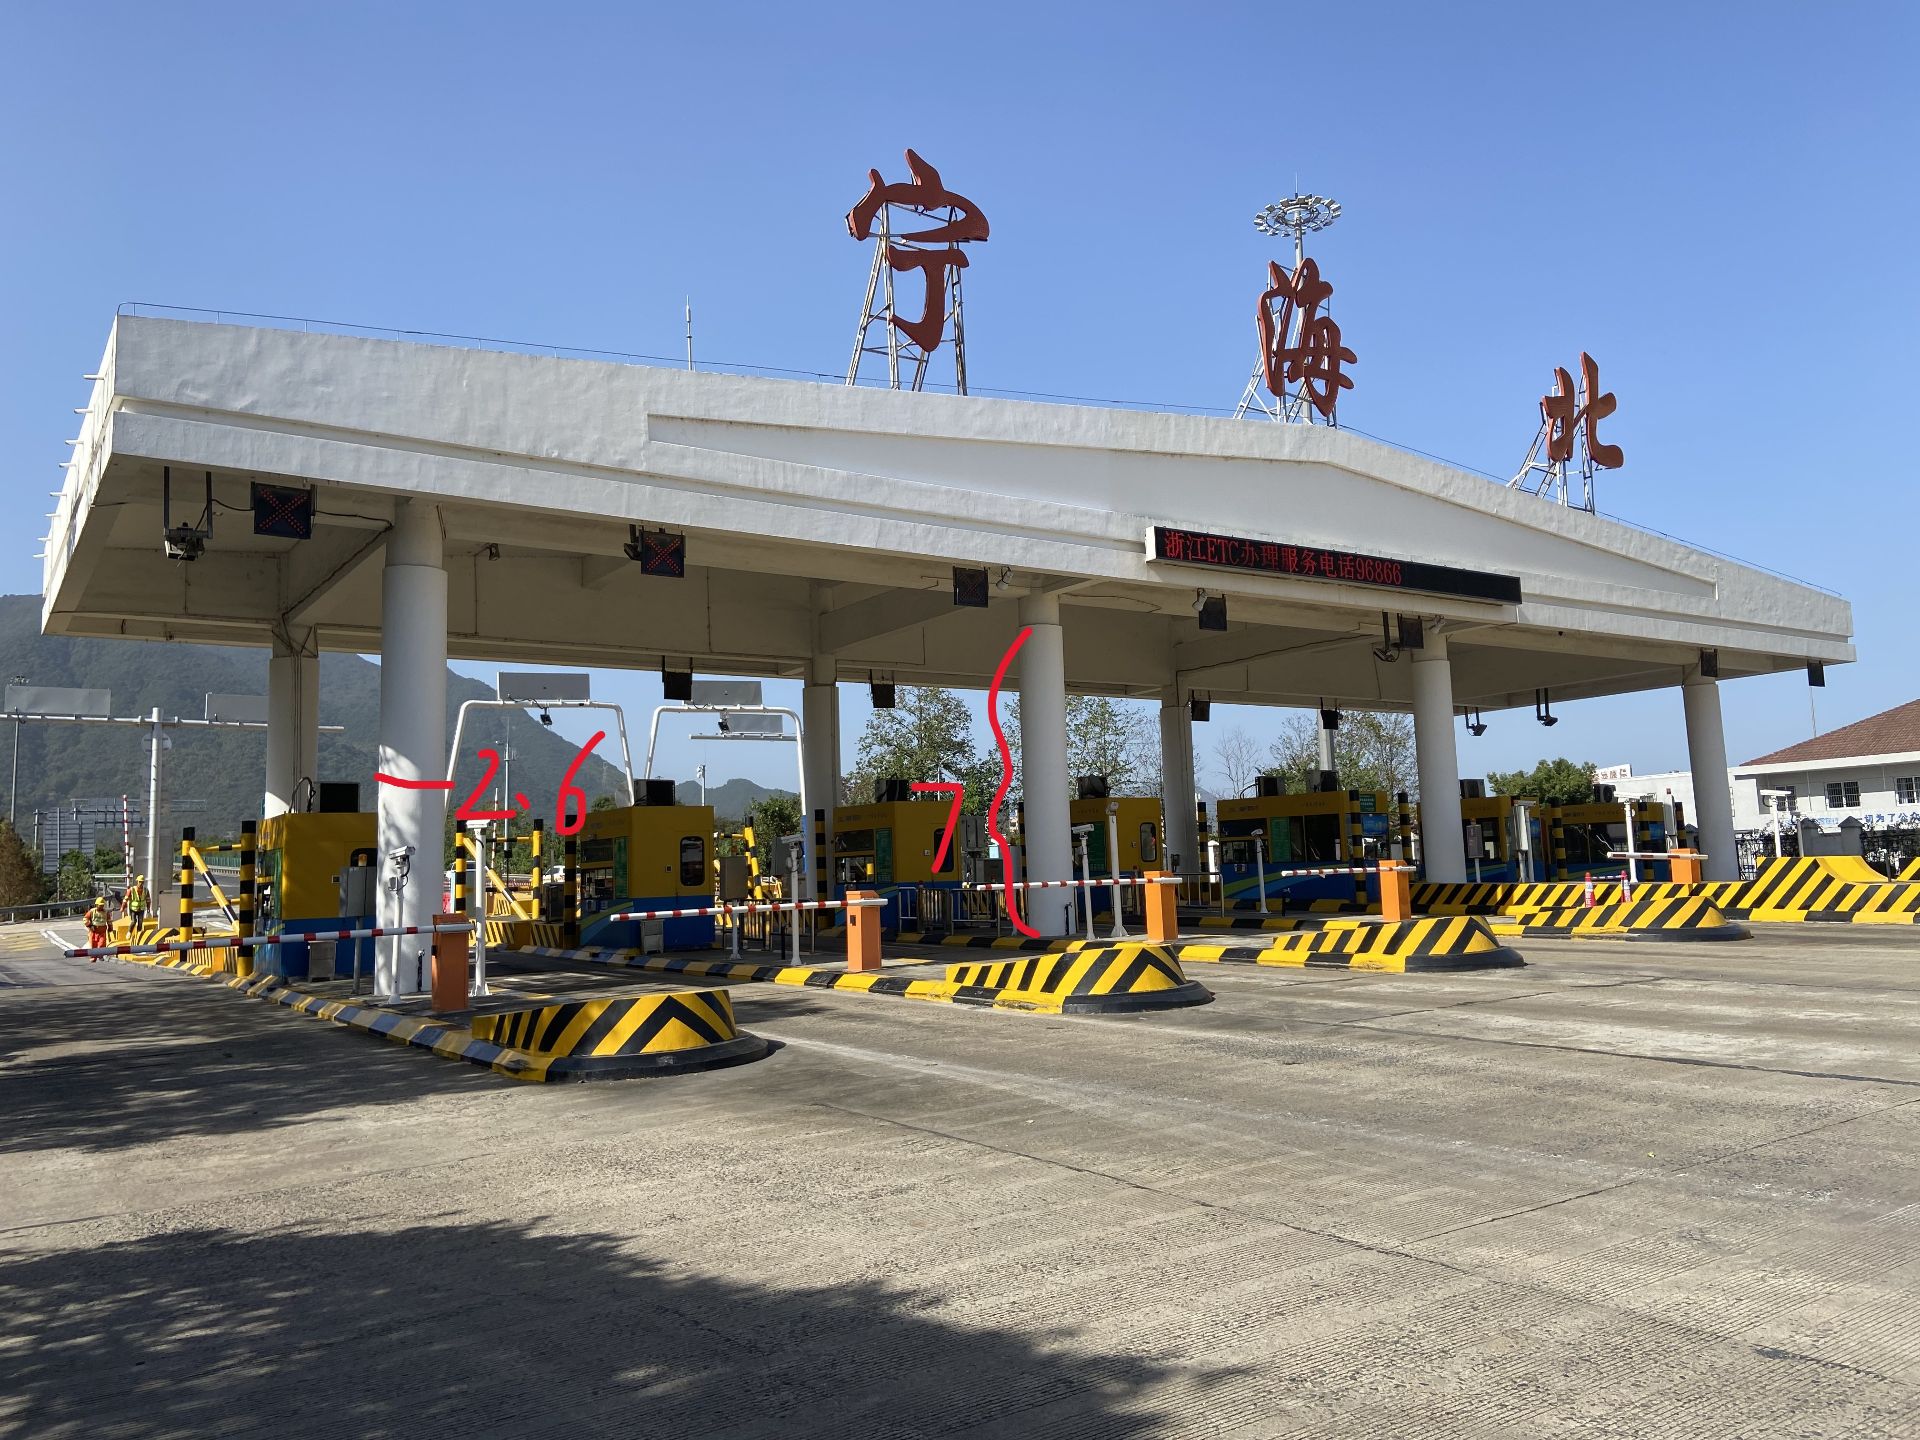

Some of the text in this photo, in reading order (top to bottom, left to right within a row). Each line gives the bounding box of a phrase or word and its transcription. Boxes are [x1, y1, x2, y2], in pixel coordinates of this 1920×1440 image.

[847, 148, 1624, 469] 宁海北
[1164, 531, 1402, 585] 浙江ETC办理服务电话96866
